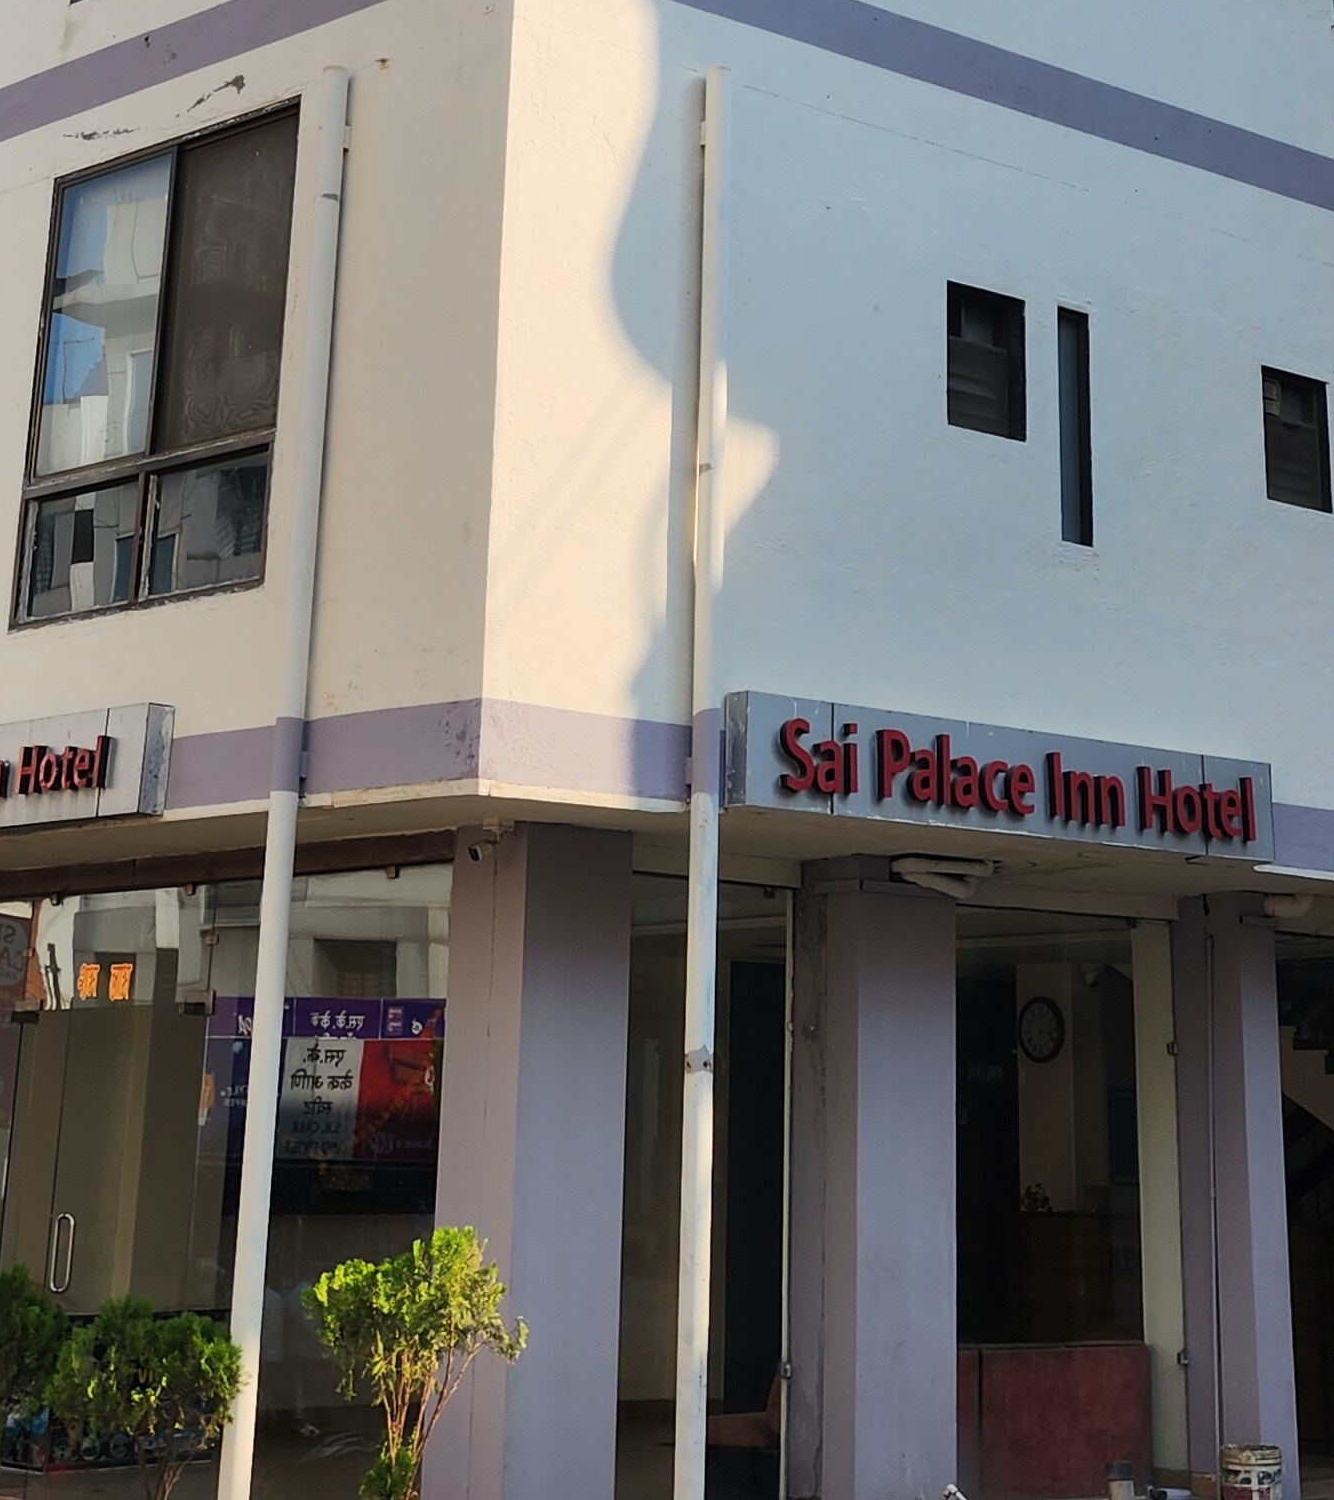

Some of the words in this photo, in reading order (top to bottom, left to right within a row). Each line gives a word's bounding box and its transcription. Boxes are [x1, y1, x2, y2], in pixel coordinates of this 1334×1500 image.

[17, 735, 112, 797] Hotel
[779, 717, 859, 795] Sai
[876, 728, 1035, 816] Palace
[1046, 751, 1125, 828] Inn
[1136, 765, 1257, 842] Hotel
